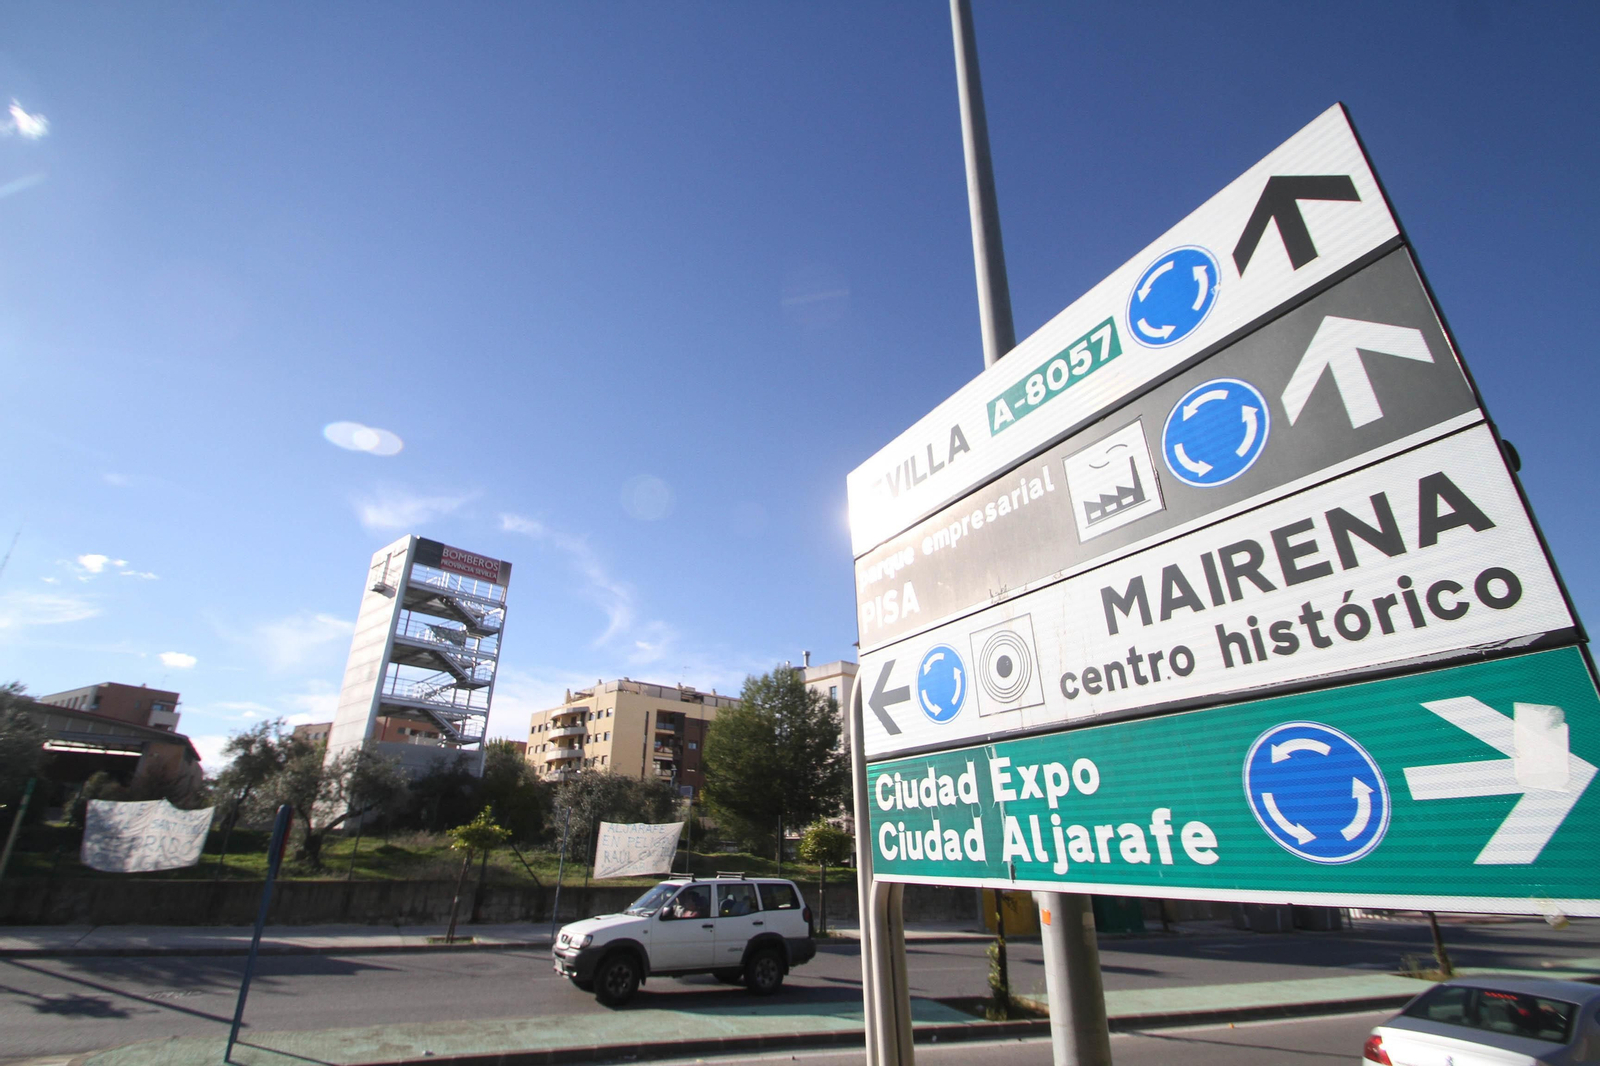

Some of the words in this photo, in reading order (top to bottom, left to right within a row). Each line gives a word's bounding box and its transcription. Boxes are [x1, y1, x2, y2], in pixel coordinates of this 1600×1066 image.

[868, 424, 971, 500] VILLA
[993, 323, 1112, 431] A-8057
[859, 546, 915, 594] parque
[922, 464, 1056, 556] empresarial
[1100, 471, 1496, 635] MAIRENA
[441, 559, 474, 572] PROVINCIA
[475, 568, 497, 579] SEVILLA
[442, 548, 498, 571] BOMBEROS
[861, 581, 920, 634] PISA
[1060, 645, 1195, 699] centro
[1216, 567, 1522, 668] histórico
[875, 760, 979, 811] Ciudad
[990, 757, 1100, 809] Expo
[602, 835, 621, 847] EN
[608, 823, 667, 834] ALJARAFE
[878, 816, 987, 861] Ciudad
[1002, 808, 1220, 875] Aljarafe
